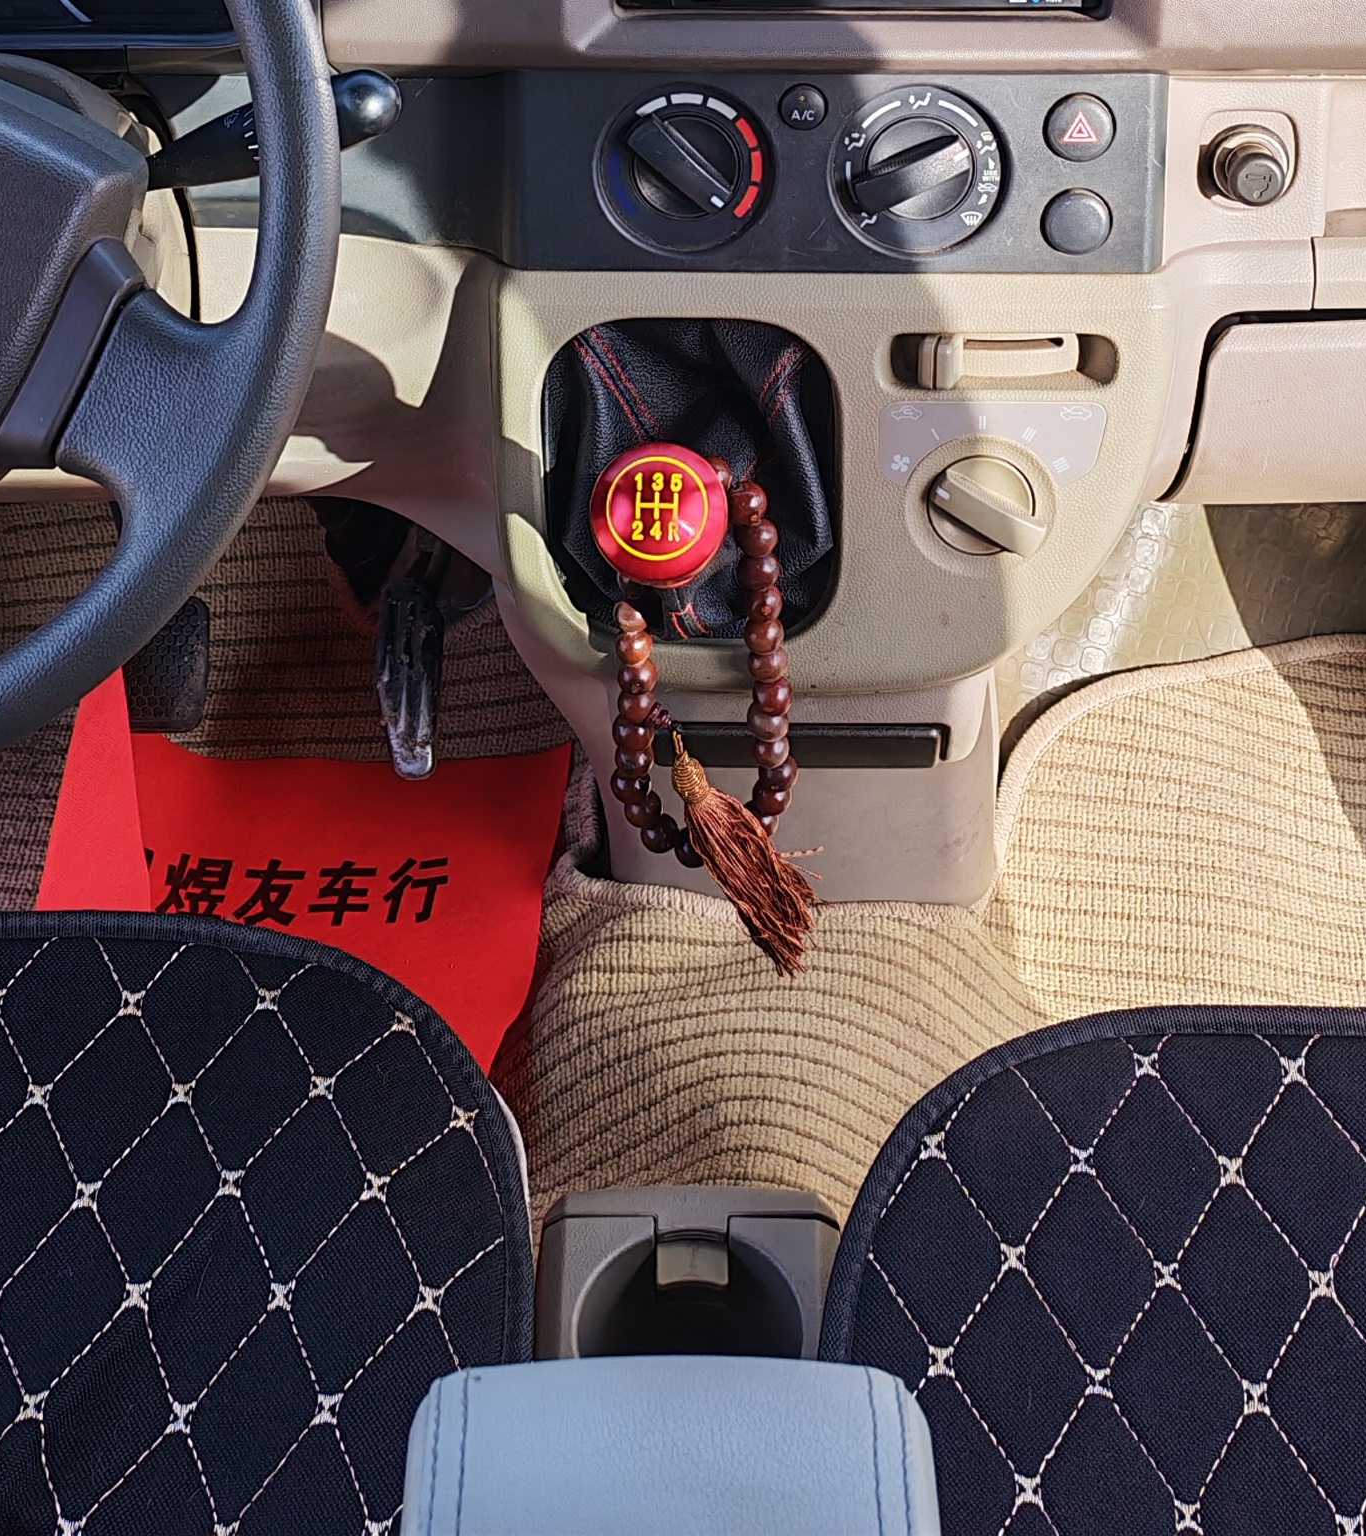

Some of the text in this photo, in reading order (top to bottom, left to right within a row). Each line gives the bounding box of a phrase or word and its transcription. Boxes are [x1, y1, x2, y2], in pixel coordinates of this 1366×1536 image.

[791, 109, 815, 121] A/C
[634, 472, 683, 492] 1 3 5
[632, 520, 680, 542] 2 4 R
[143, 848, 449, 926] 煜友车行
